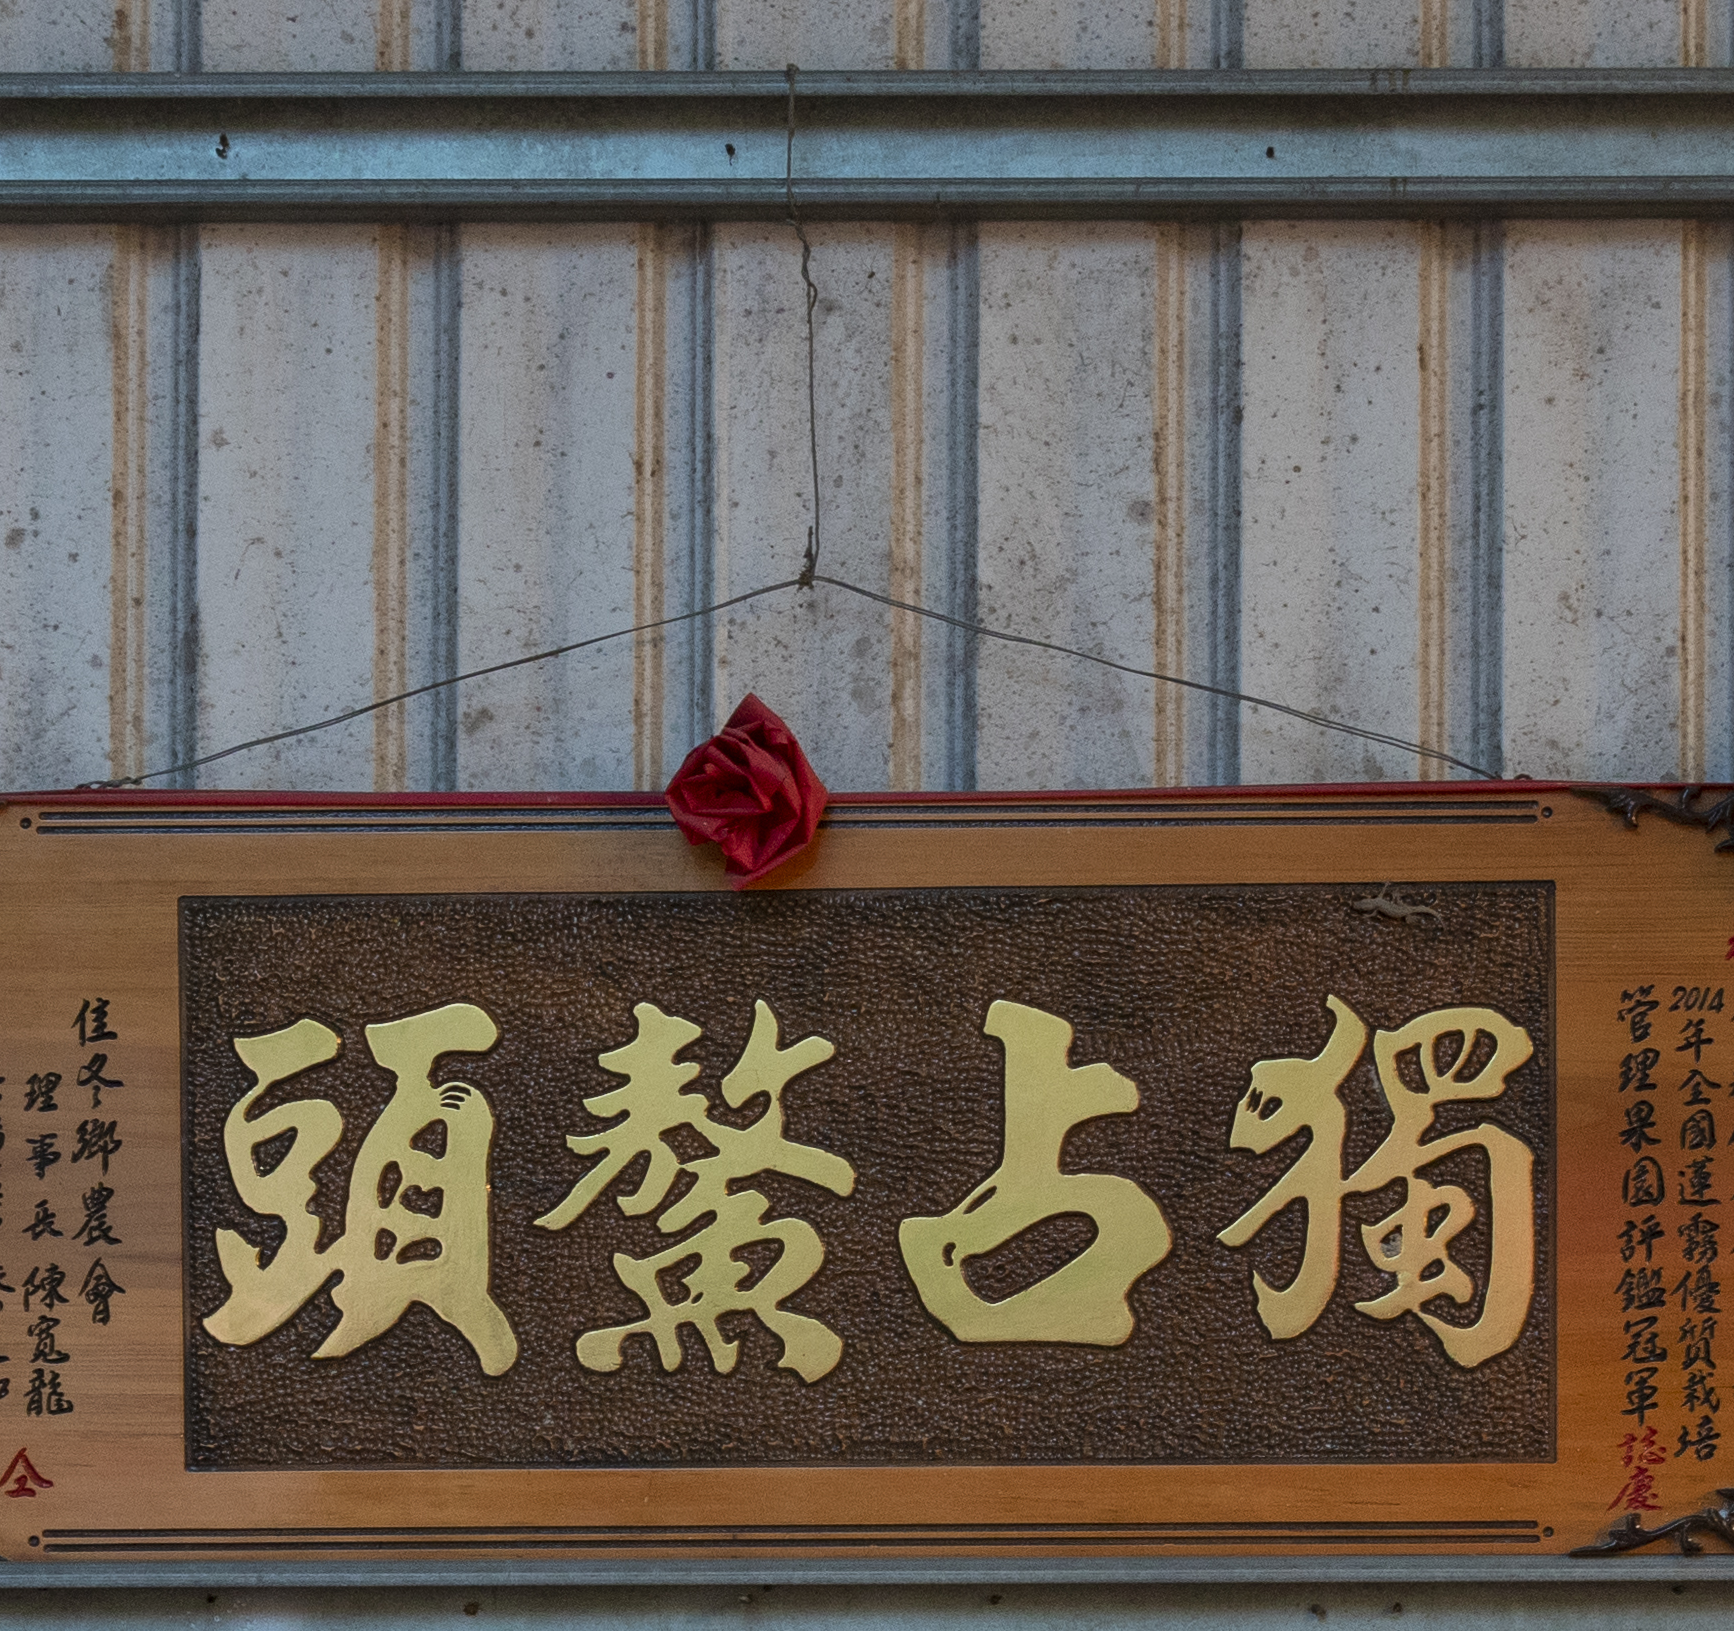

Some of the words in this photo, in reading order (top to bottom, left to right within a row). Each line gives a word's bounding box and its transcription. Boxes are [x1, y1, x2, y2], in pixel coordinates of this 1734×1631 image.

[71, 997, 125, 1325] 佳冬鄉農會
